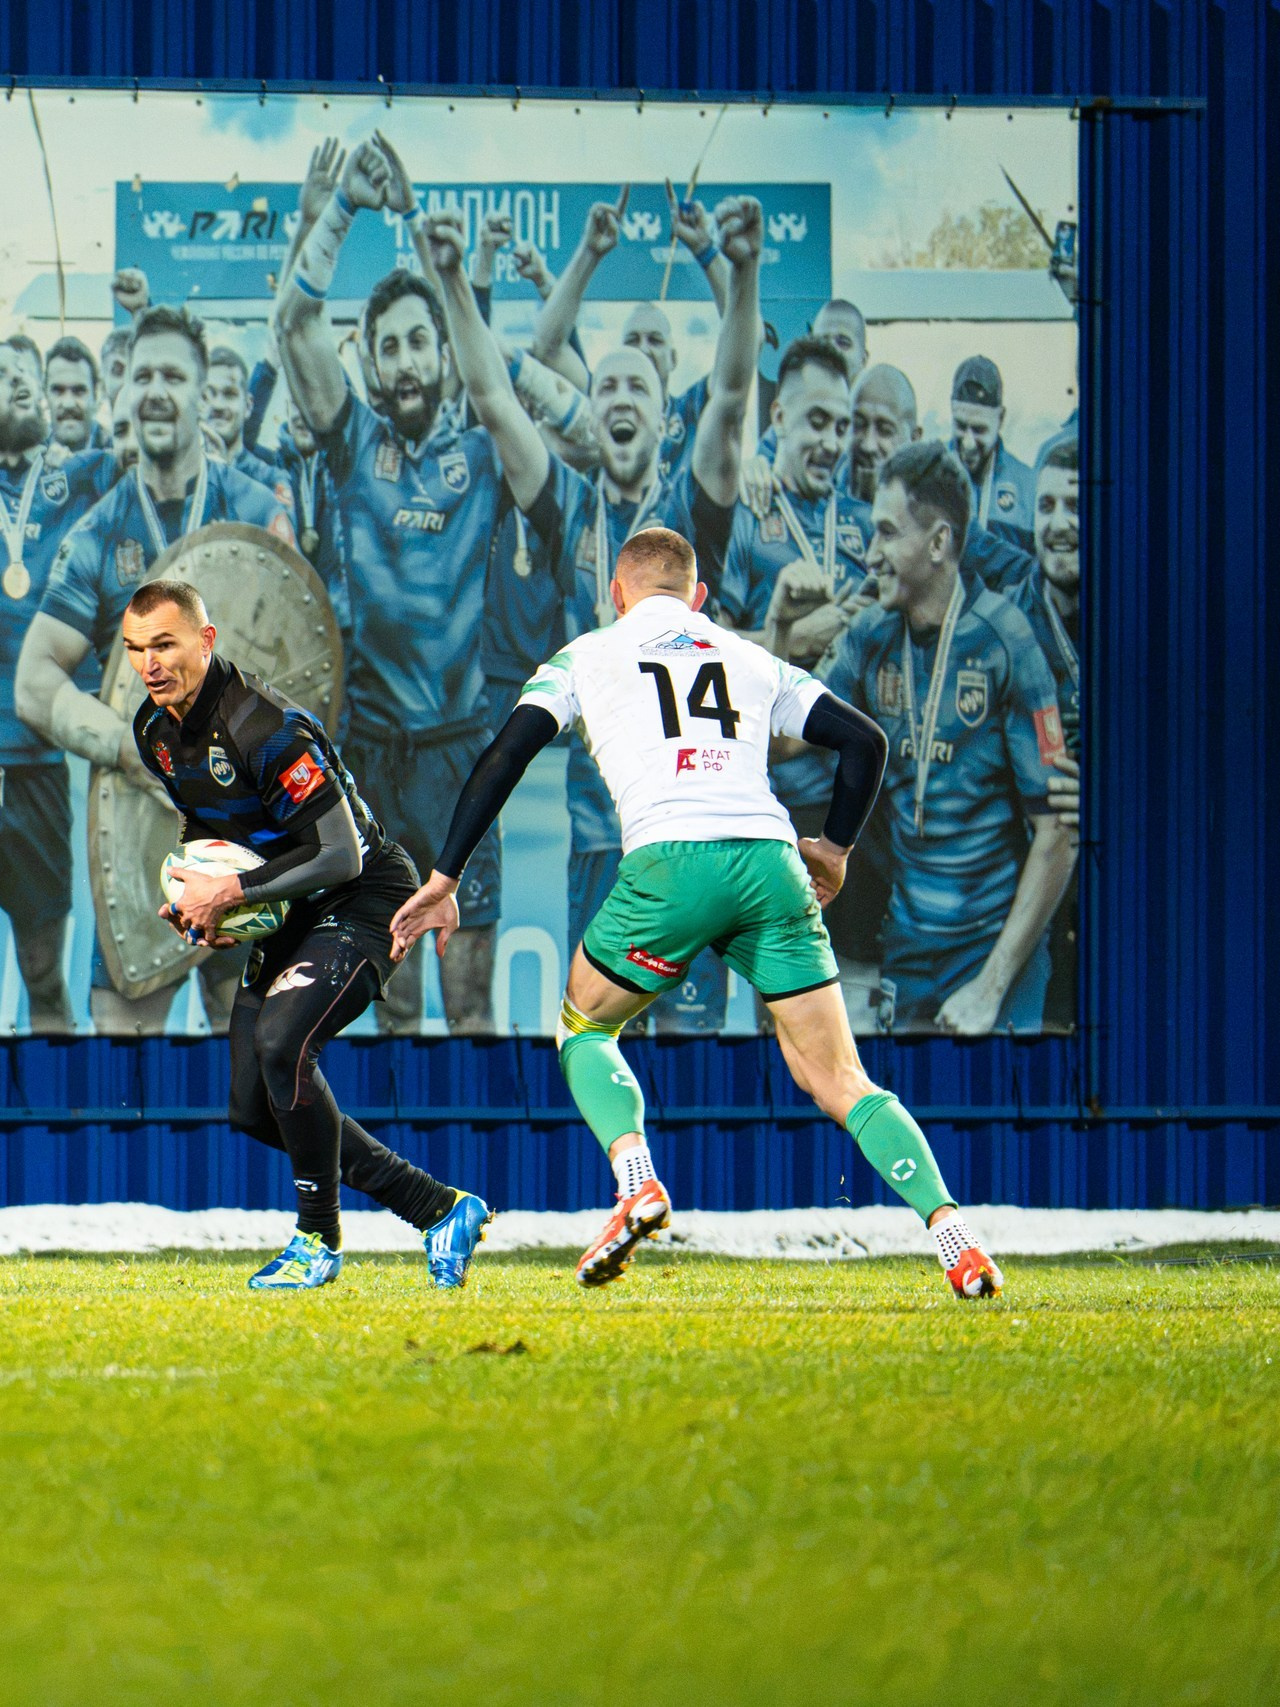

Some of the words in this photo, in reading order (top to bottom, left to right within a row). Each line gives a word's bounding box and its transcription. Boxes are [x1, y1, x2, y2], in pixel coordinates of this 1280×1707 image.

[189, 210, 278, 240] PARI
[393, 509, 445, 531] PARI
[637, 661, 741, 740] 14
[701, 749, 731, 761] АГАТ
[900, 737, 954, 763] PRI
[703, 760, 723, 772] РФ
